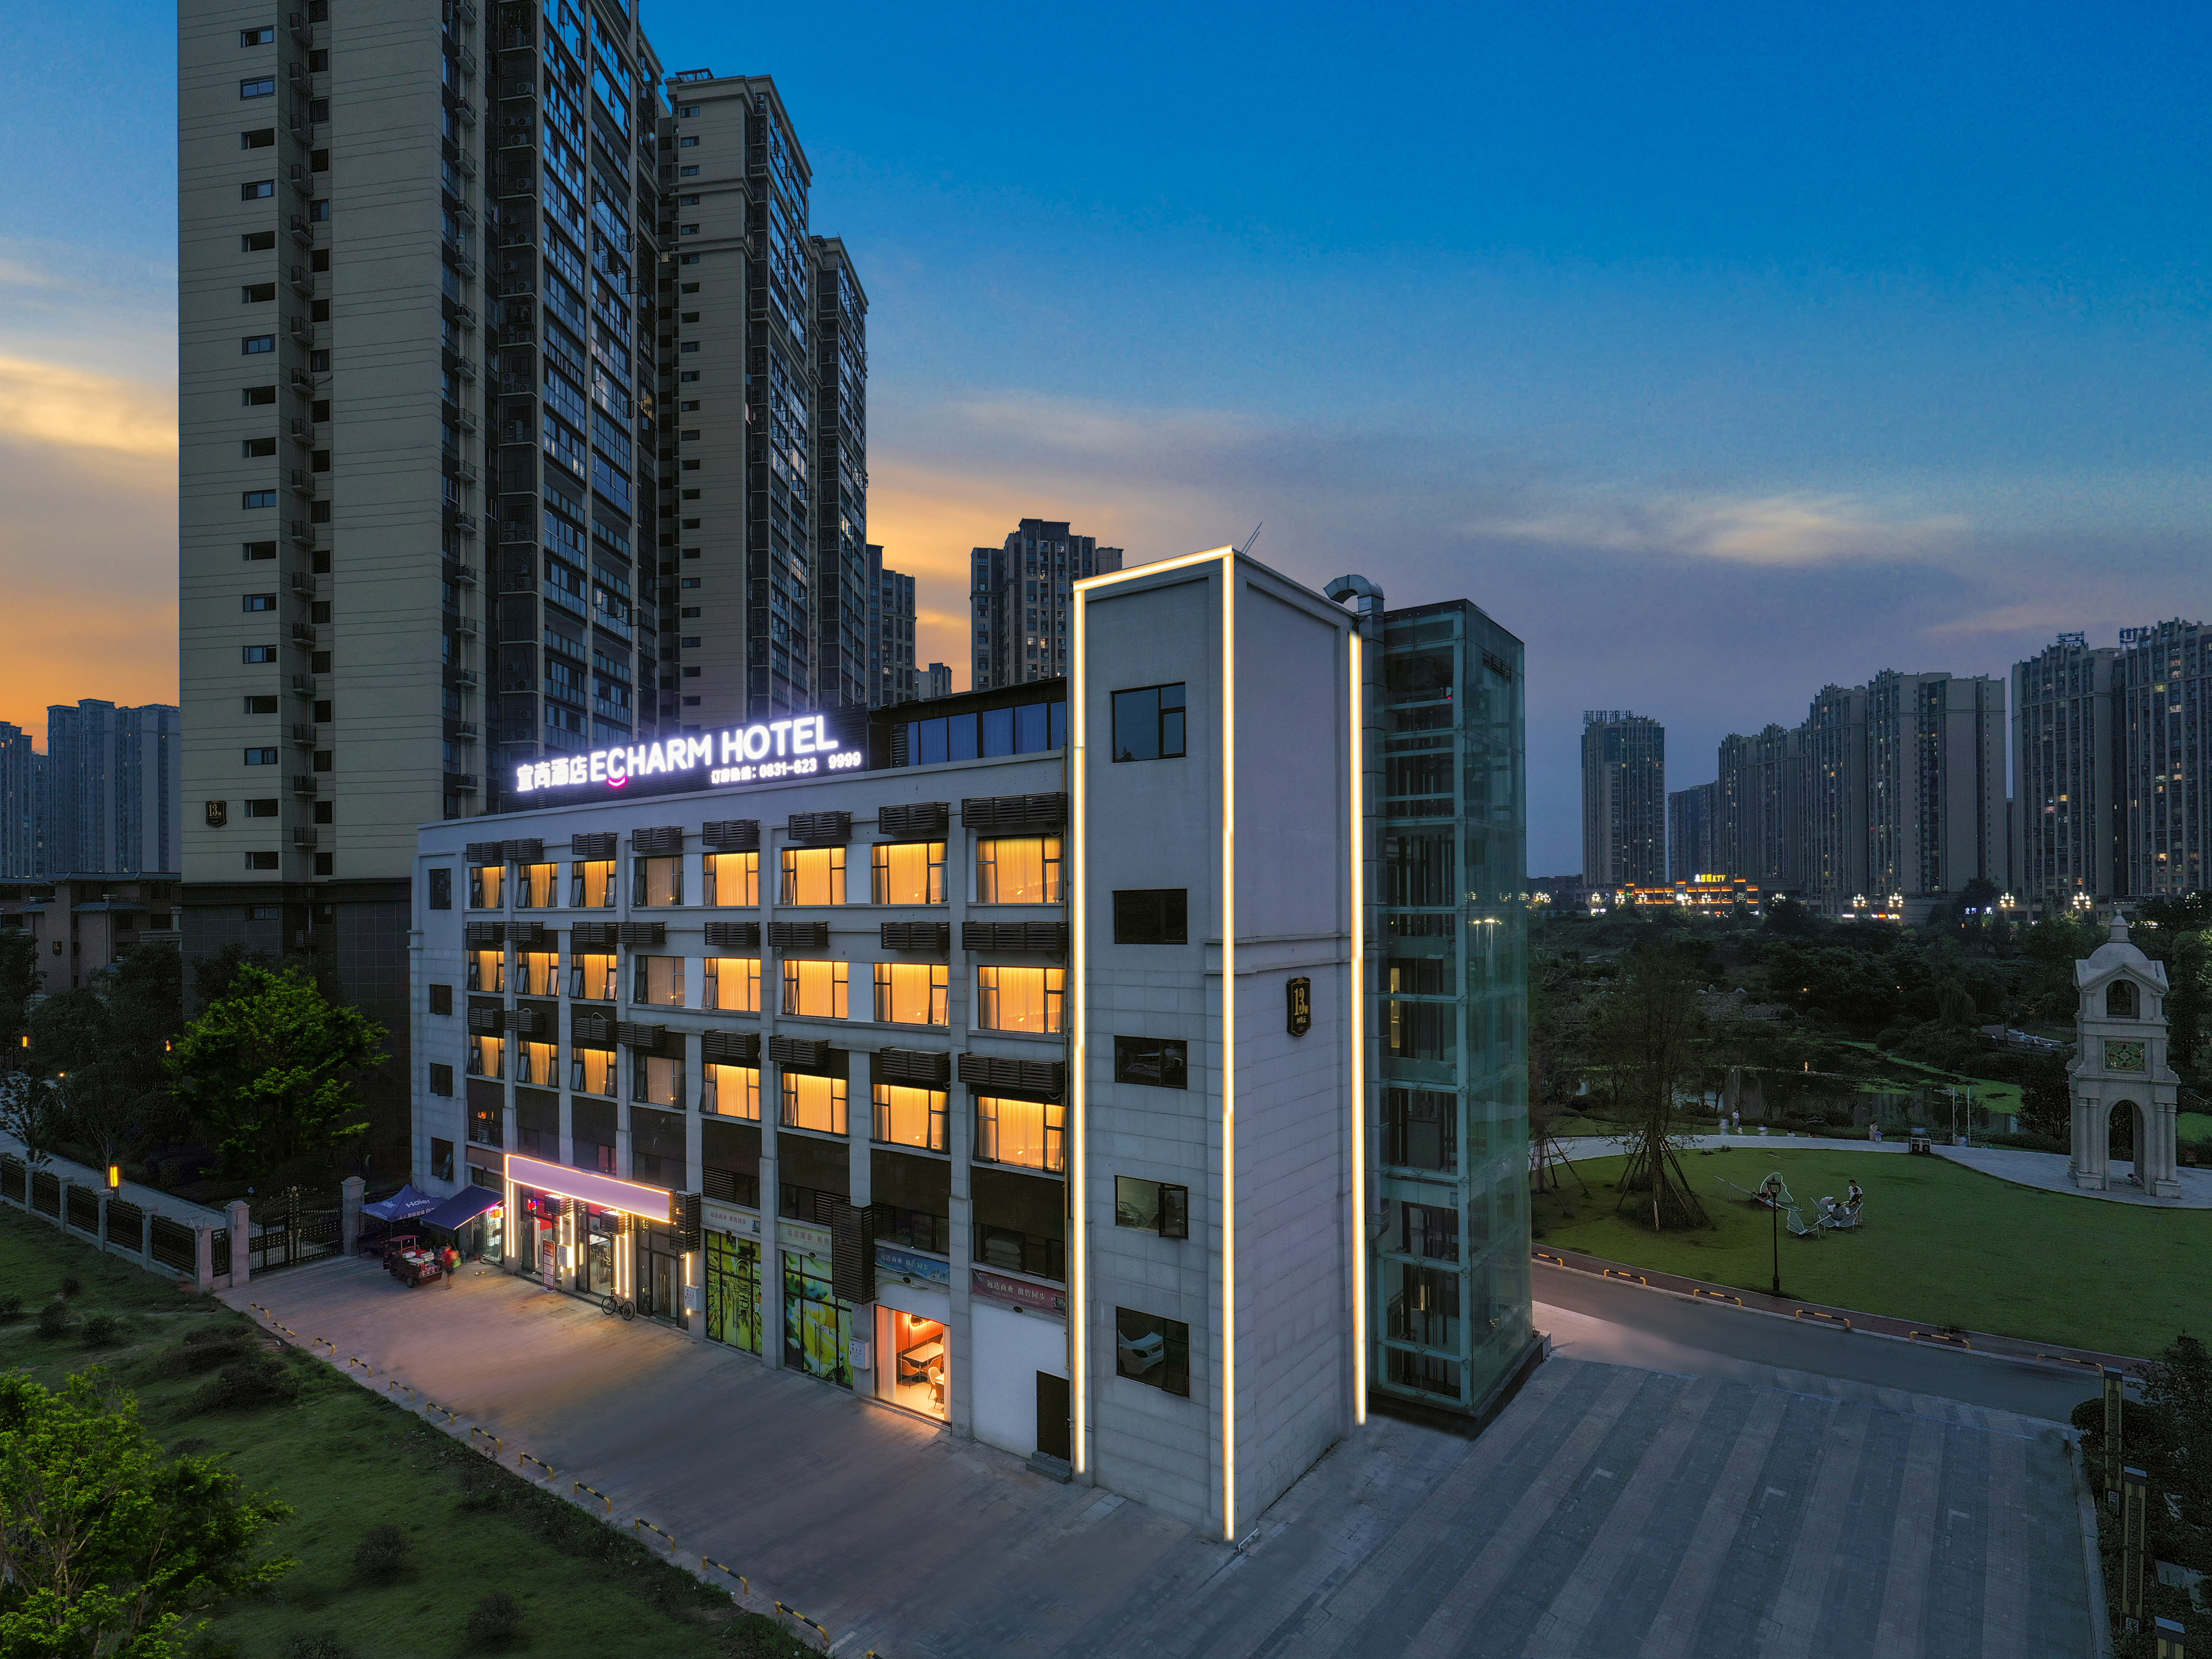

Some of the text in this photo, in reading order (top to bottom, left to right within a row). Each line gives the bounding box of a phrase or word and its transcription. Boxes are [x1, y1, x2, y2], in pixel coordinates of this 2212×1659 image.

[589, 734, 712, 782] ECHARM
[722, 715, 838, 764] HOTEL
[828, 751, 862, 769] 9999
[405, 1199, 430, 1208] Haier
[787, 1228, 812, 1241] 远达商业
[880, 1253, 902, 1264] 远达商业
[987, 1280, 1014, 1293] 远达商业
[1018, 1287, 1046, 1300] 租售同步
